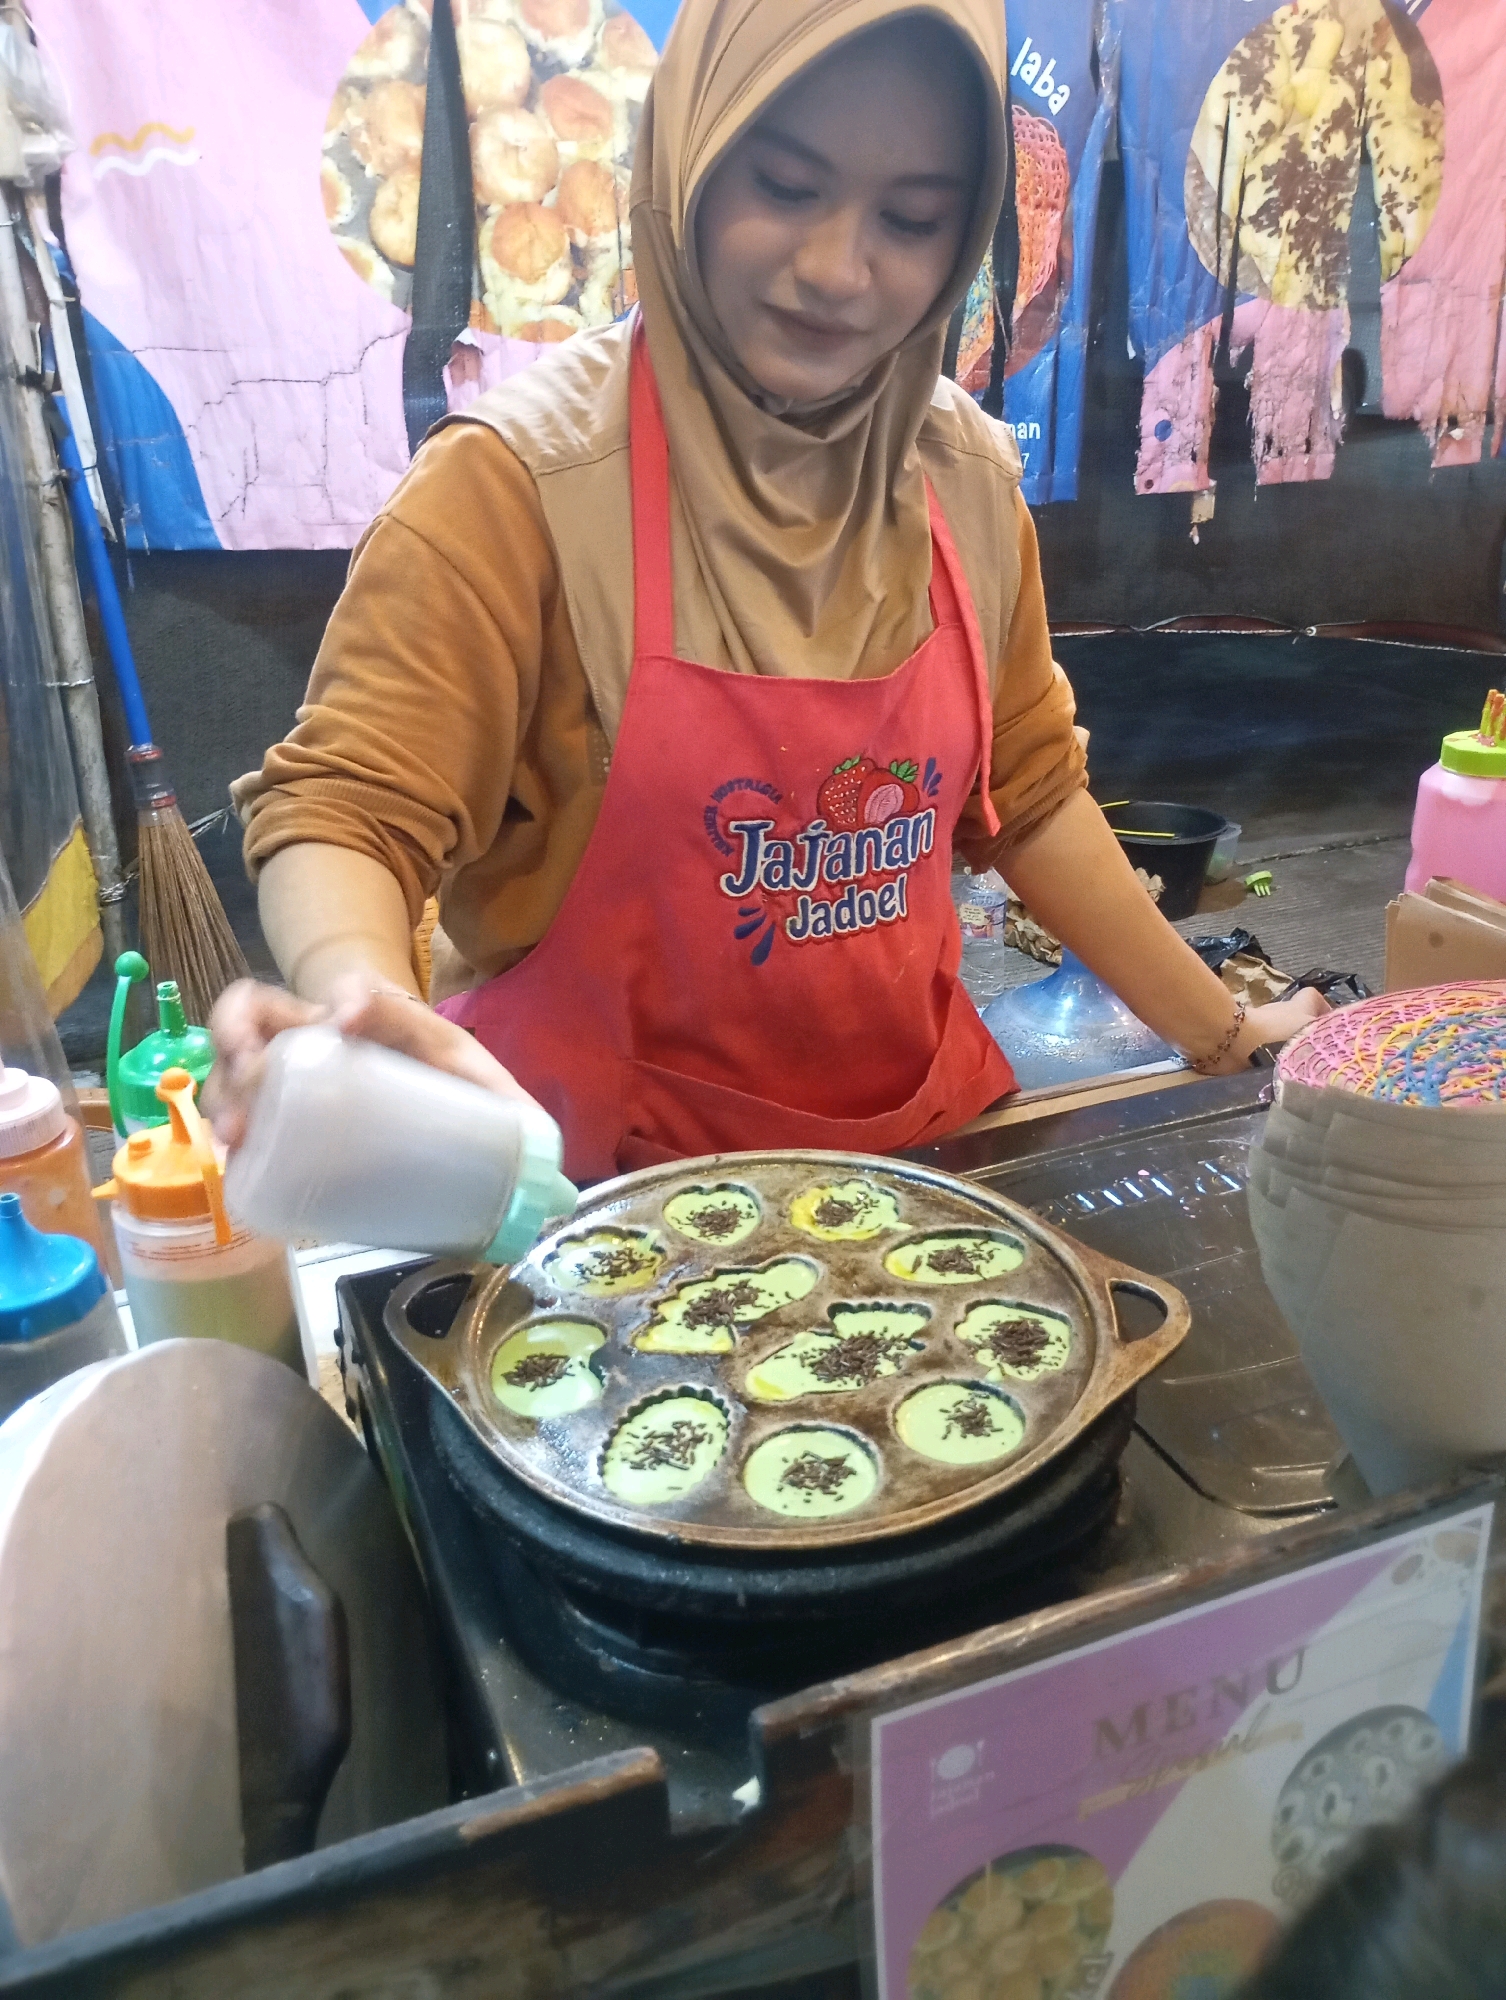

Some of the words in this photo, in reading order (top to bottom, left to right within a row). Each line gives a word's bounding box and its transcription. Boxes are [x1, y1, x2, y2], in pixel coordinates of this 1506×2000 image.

[1010, 36, 1071, 116] laba
[719, 808, 936, 897] Jajanan
[786, 873, 907, 940] Jadoel
[1091, 1646, 1306, 1760] MENU
